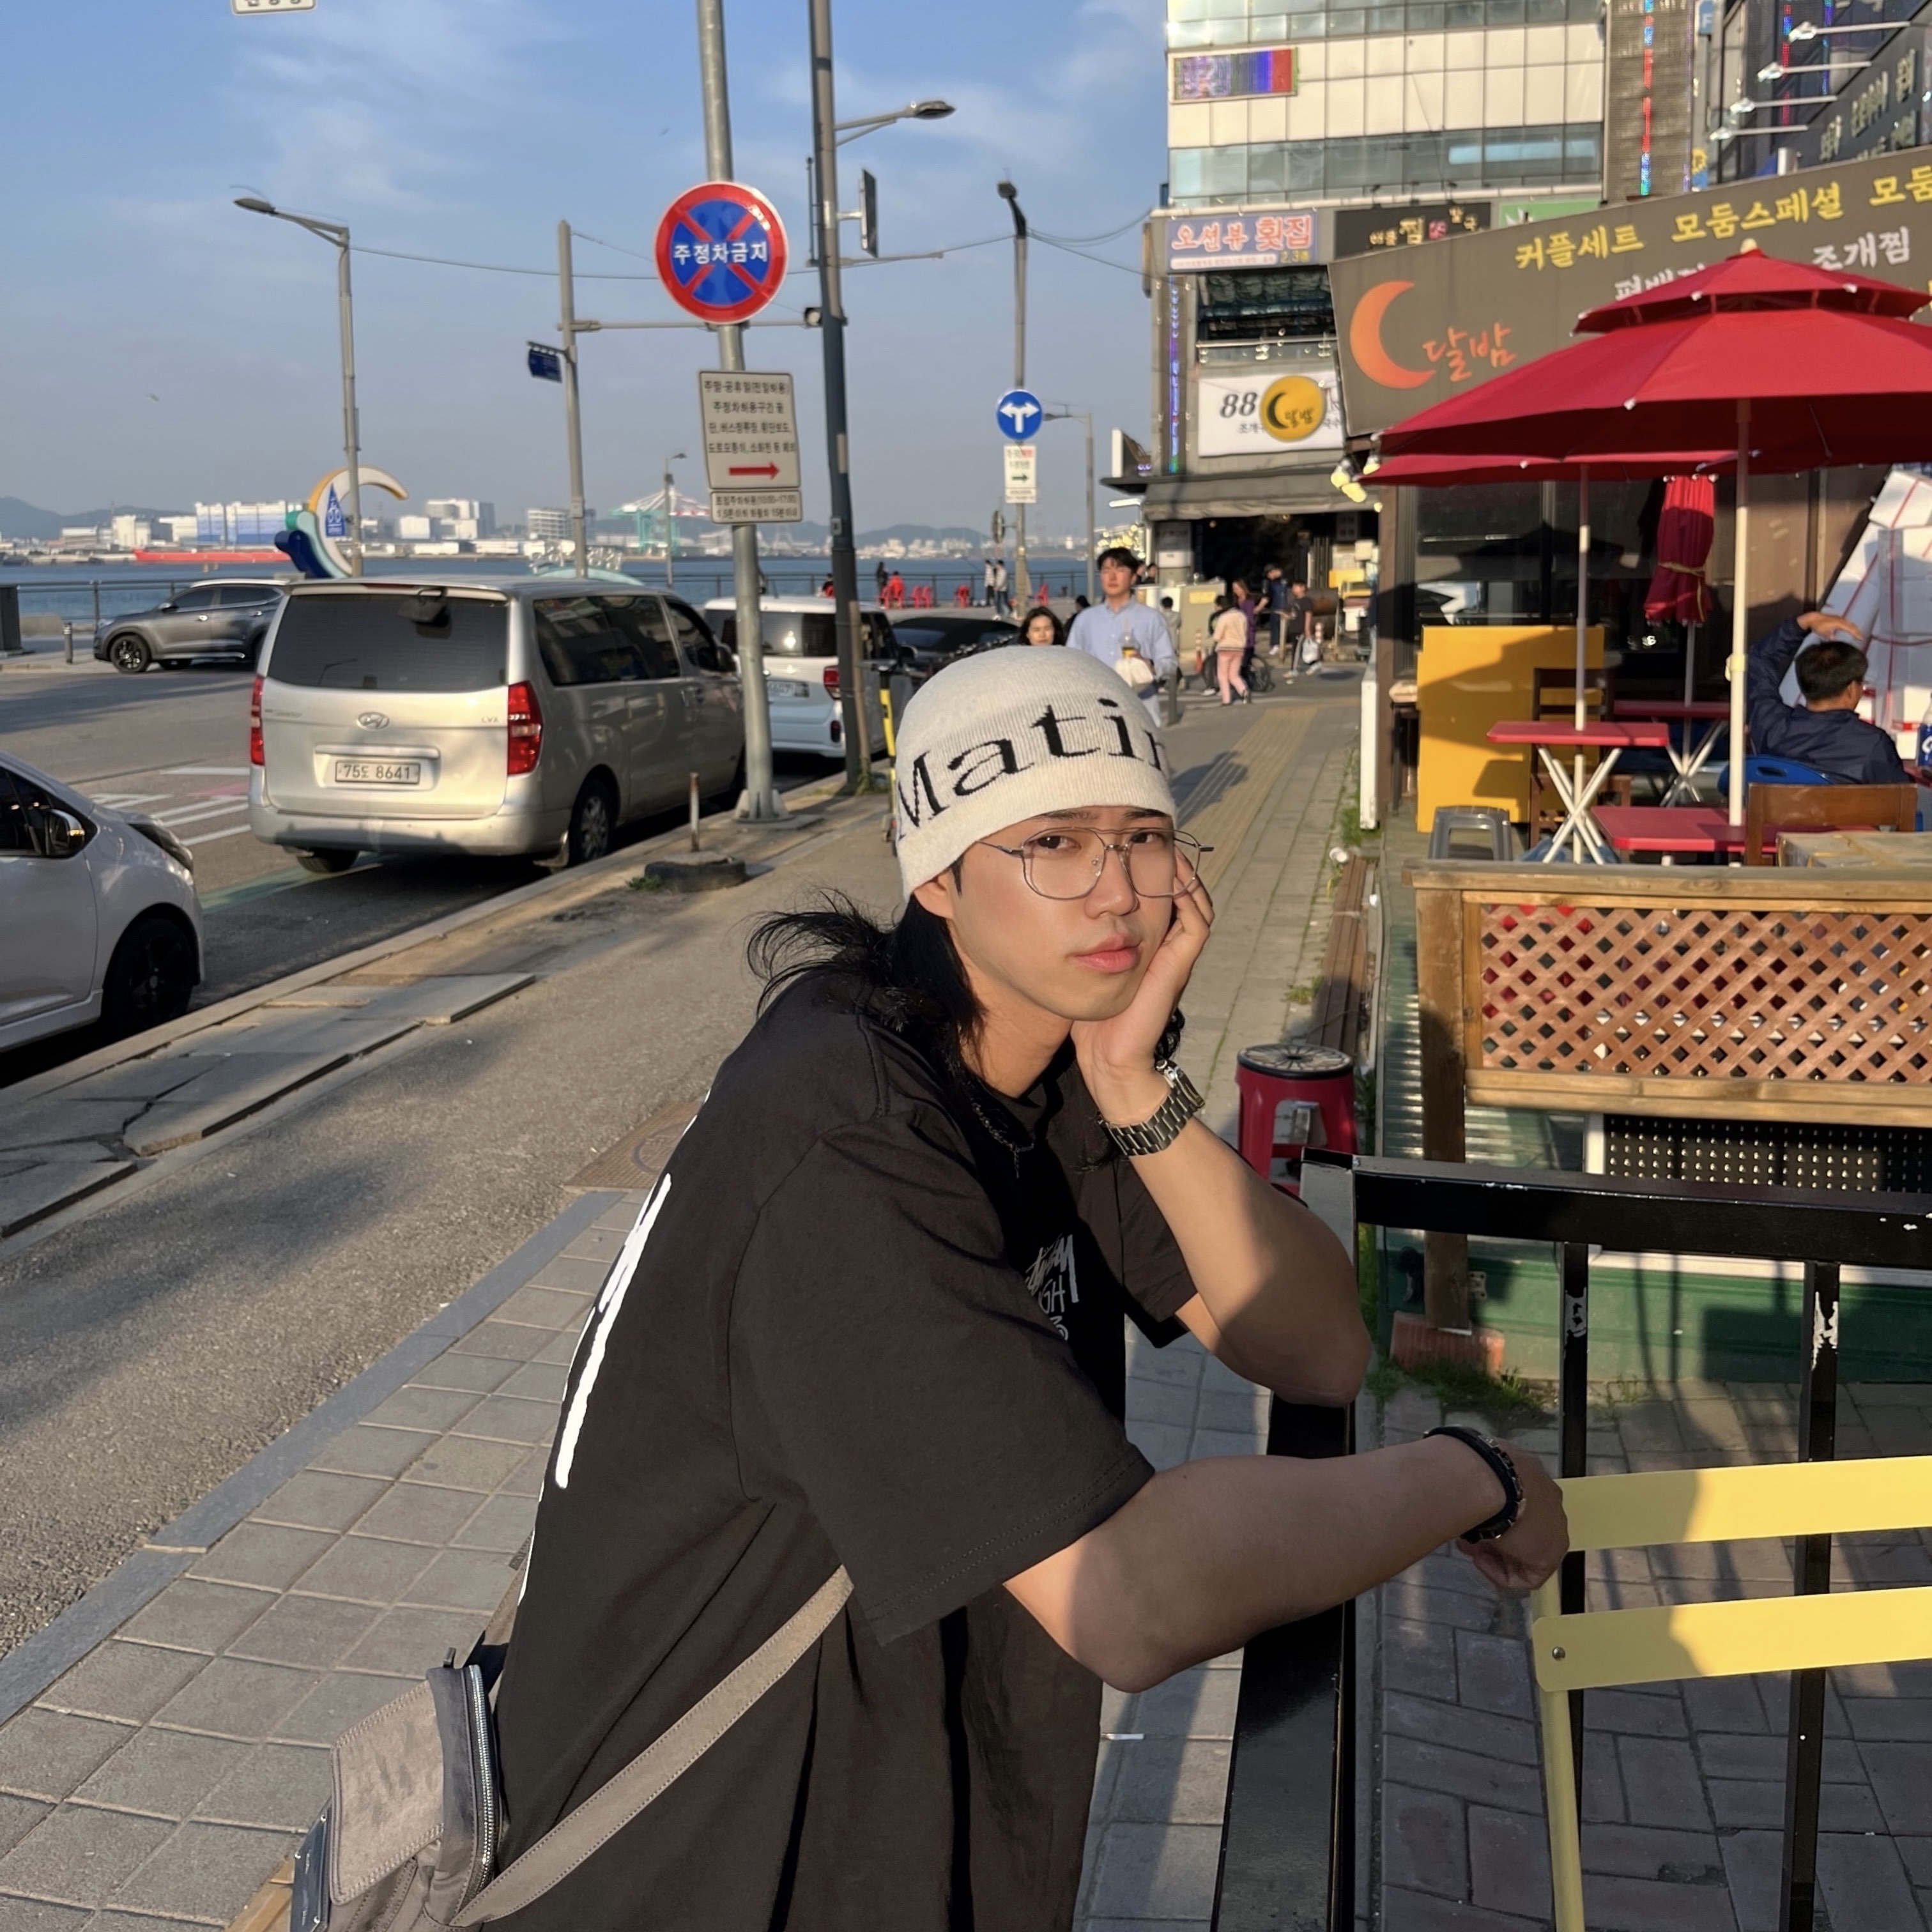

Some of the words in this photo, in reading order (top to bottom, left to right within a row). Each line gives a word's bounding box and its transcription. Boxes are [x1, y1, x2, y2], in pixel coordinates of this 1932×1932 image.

[1172, 222, 1248, 252] 오션뷰
[1254, 214, 1312, 251] 횟집
[1515, 225, 1644, 271] 커플세트
[1671, 181, 1844, 242] 모둠스페셜
[673, 241, 768, 265] 주정차금지
[1813, 226, 1910, 271] 조개찜
[1422, 321, 1517, 382] 달밤
[1220, 392, 1258, 418] 88
[344, 764, 369, 778] 75도
[376, 765, 410, 780] 8641
